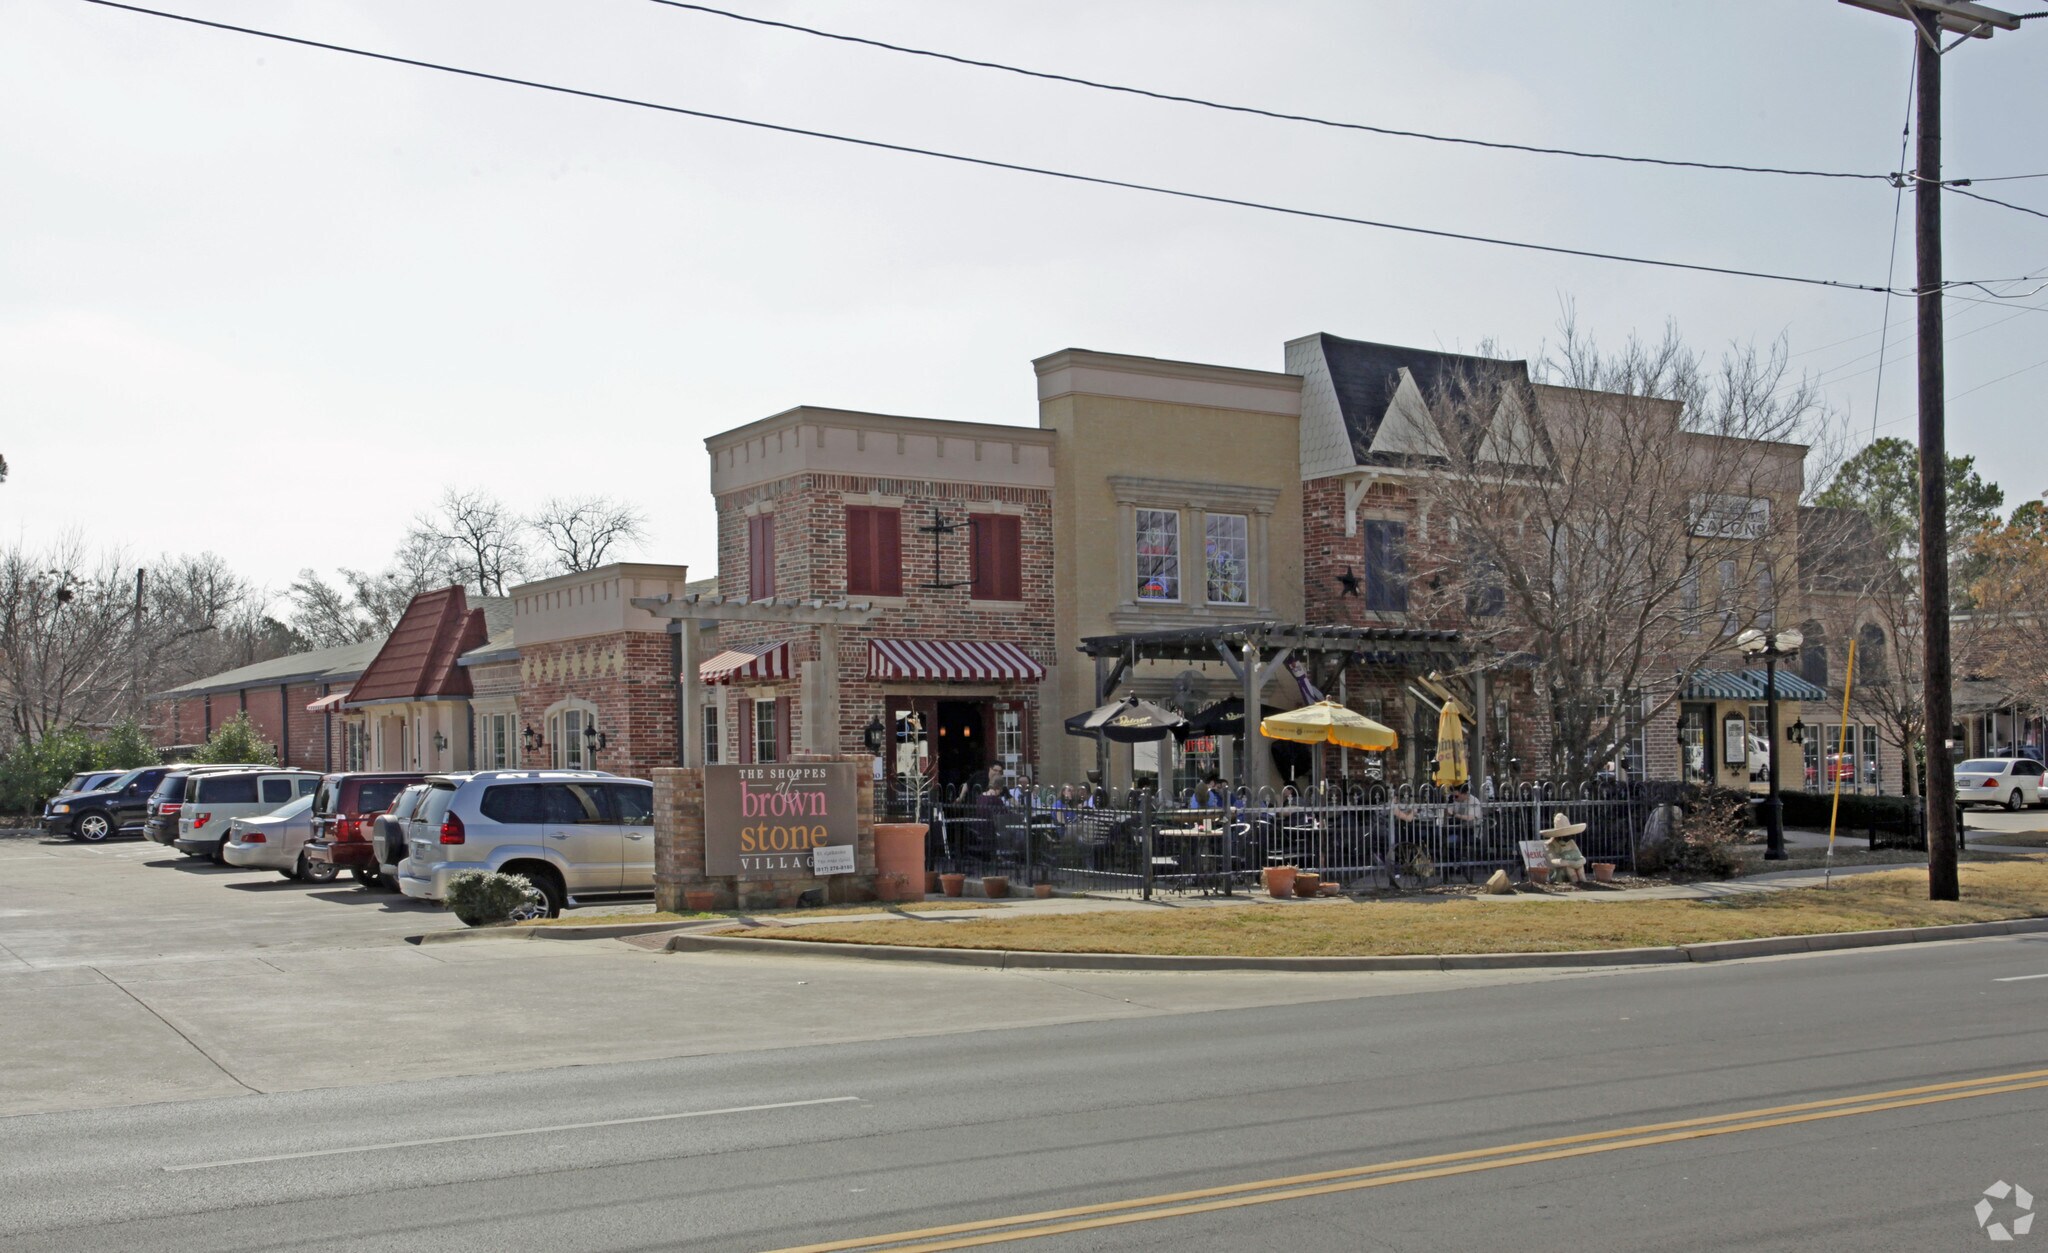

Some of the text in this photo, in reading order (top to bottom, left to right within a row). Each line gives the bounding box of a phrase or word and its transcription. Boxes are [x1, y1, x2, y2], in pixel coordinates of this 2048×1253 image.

[739, 768, 827, 779] THE SHOPPES
[740, 780, 828, 817] brown
[741, 820, 828, 852] stone
[741, 856, 815, 870] VILLAG
